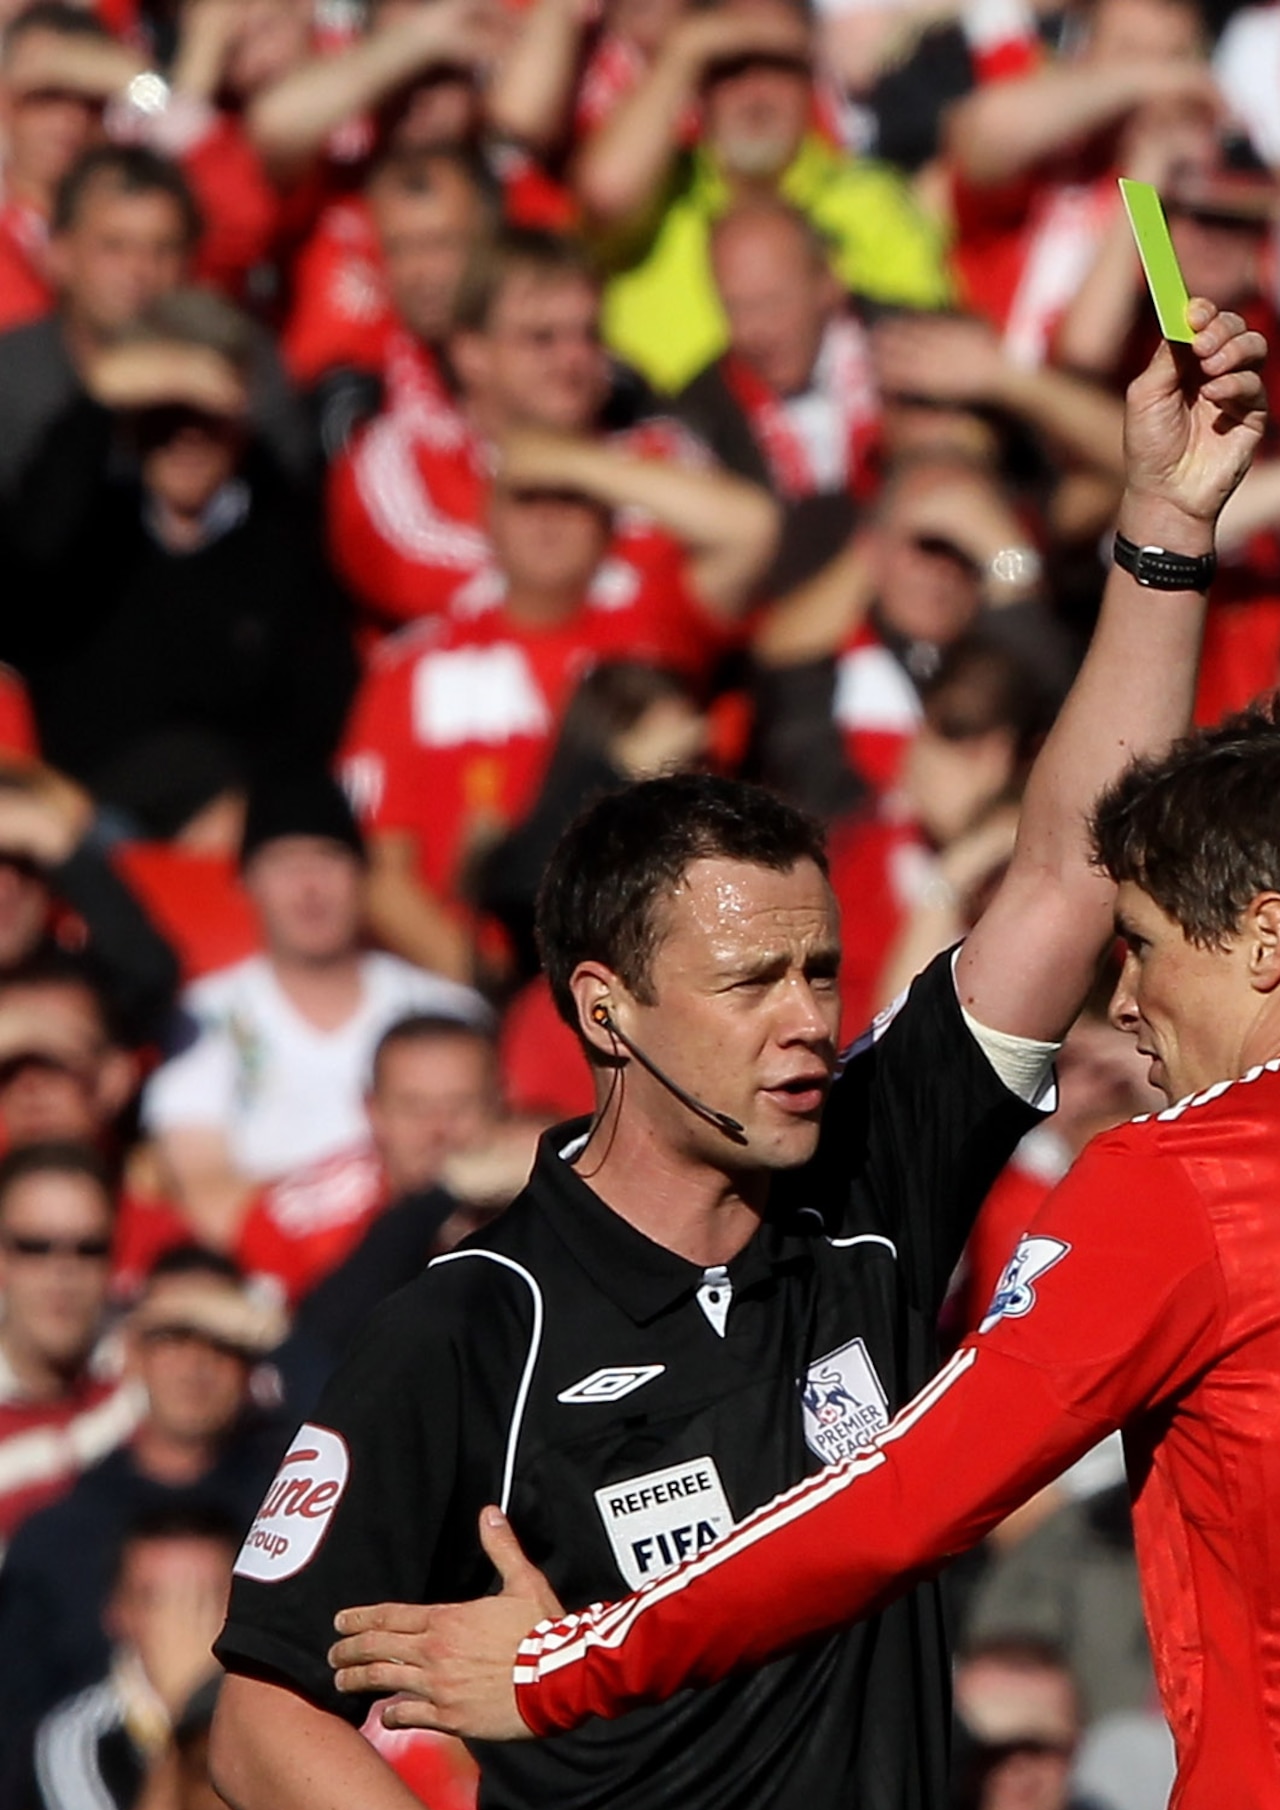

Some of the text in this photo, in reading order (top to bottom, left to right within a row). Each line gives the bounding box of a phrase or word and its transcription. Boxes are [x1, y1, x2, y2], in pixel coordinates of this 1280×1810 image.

[815, 1404, 882, 1451] PREMIER
[609, 1470, 713, 1519] REFEREE
[631, 1519, 718, 1574] FIFA
